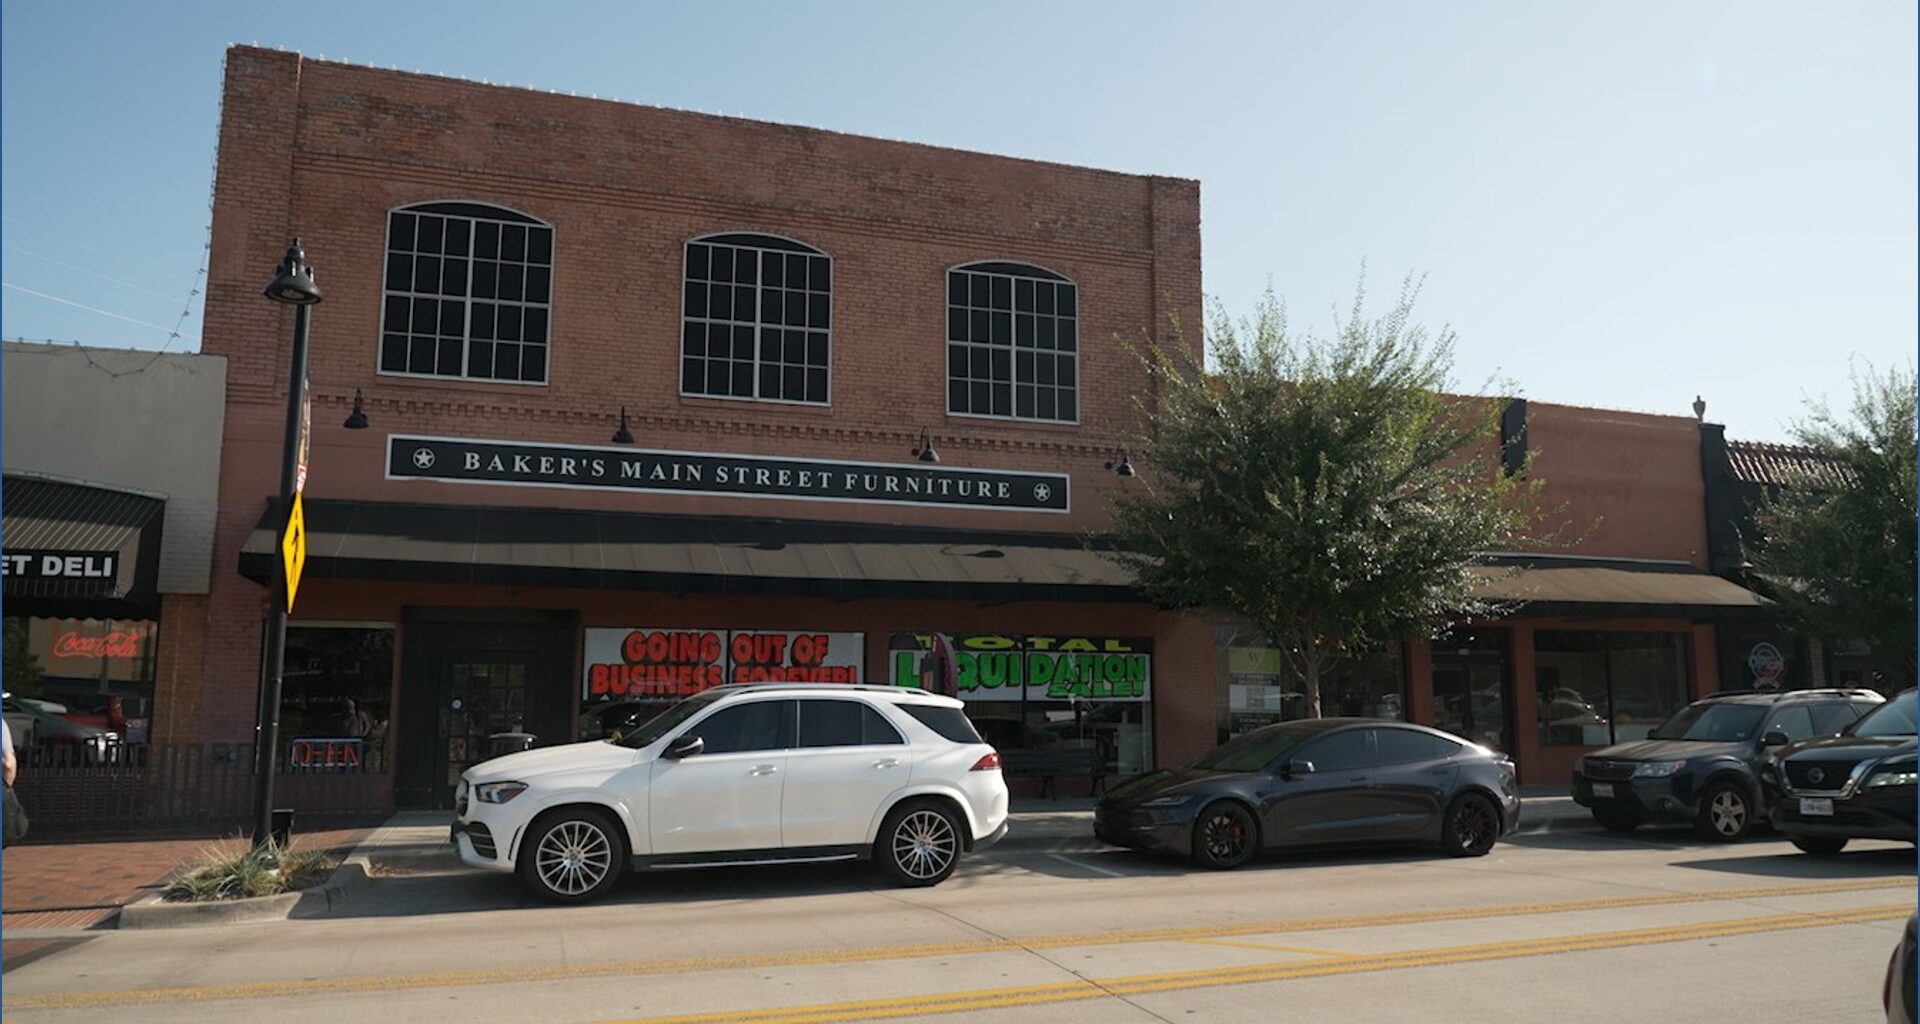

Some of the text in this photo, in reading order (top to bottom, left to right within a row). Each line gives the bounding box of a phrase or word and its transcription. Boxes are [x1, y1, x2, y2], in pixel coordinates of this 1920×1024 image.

[464, 451, 1011, 498] BAKER'S MAIN STREET FURNITURE
[41, 555, 112, 577] DELI
[622, 630, 829, 665] GOING OUT OF
[589, 663, 724, 696] BUSINESS
[896, 652, 1147, 692] LQUIDATION
[1047, 680, 1146, 698] SALE!
